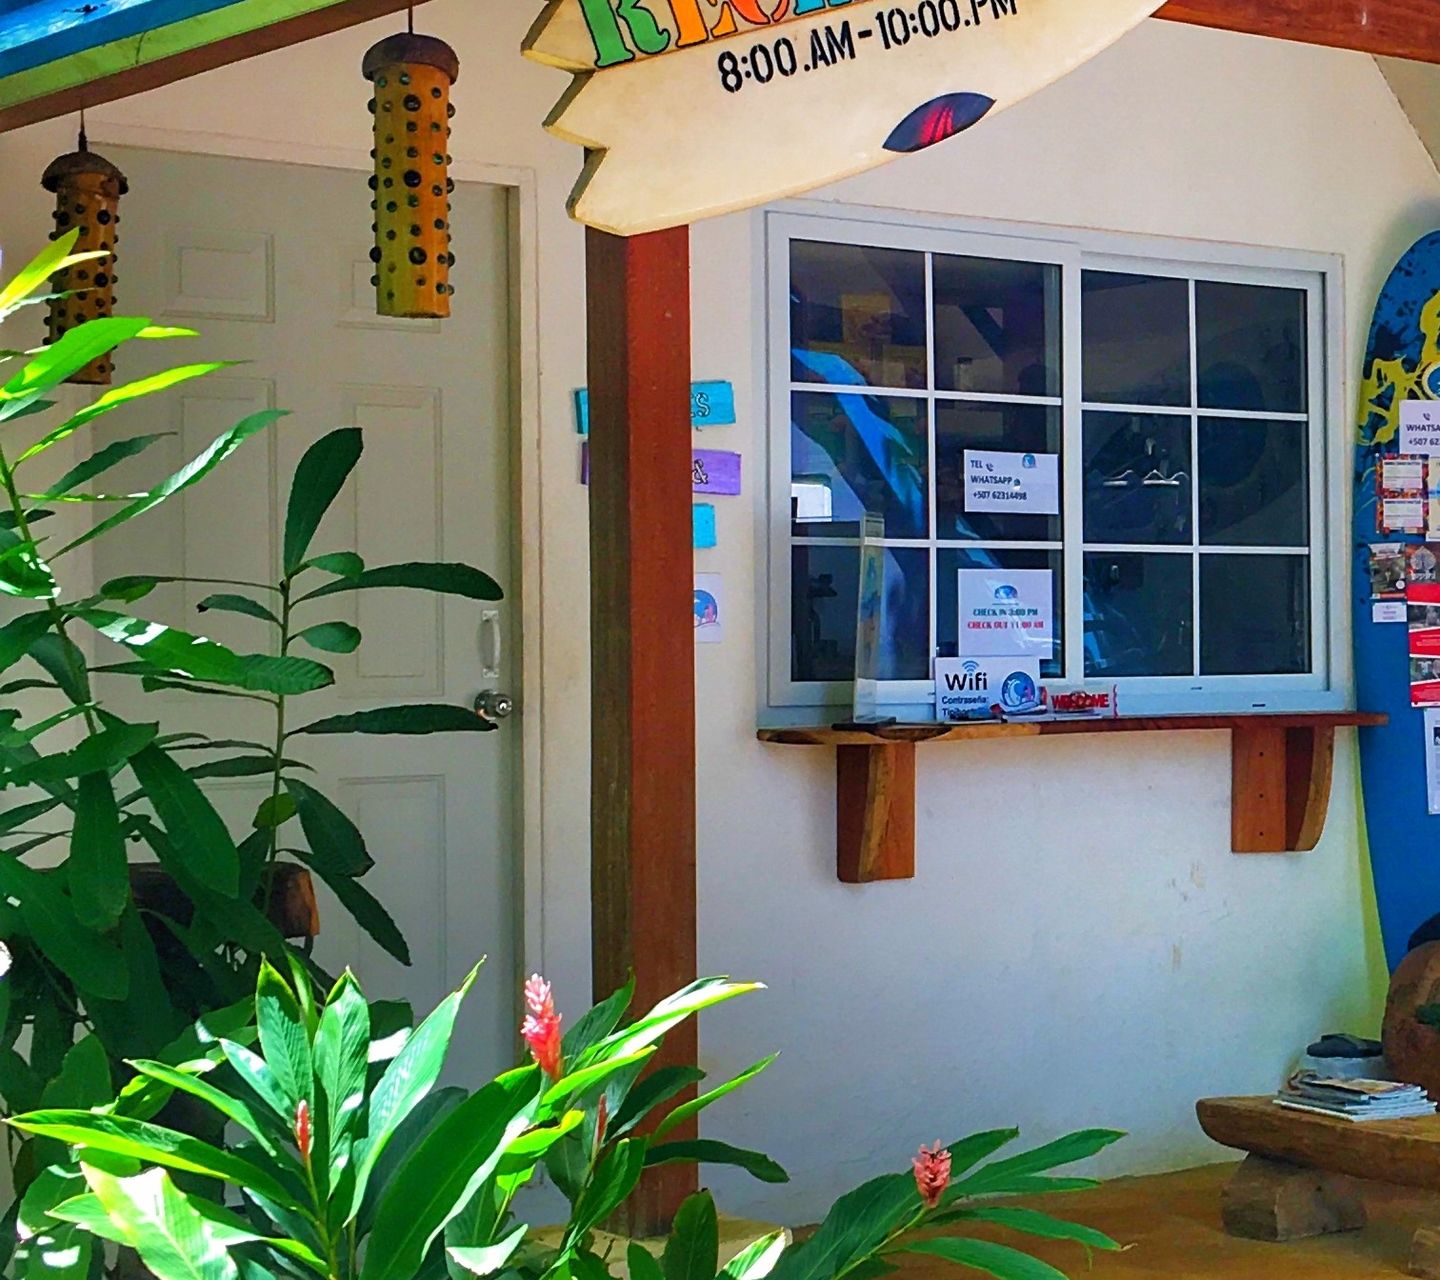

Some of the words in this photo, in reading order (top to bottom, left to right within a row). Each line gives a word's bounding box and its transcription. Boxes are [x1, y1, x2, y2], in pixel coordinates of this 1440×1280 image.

[1408, 438, 1428, 446] +507
[970, 460, 983, 468] TEL
[970, 475, 1012, 485] WHATSAPP
[973, 491, 990, 499] +507
[973, 608, 998, 616] CHECK
[1027, 608, 1038, 616] PM
[967, 621, 992, 629] CHECK
[994, 621, 1008, 629] OUT
[944, 672, 988, 691] Wifi
